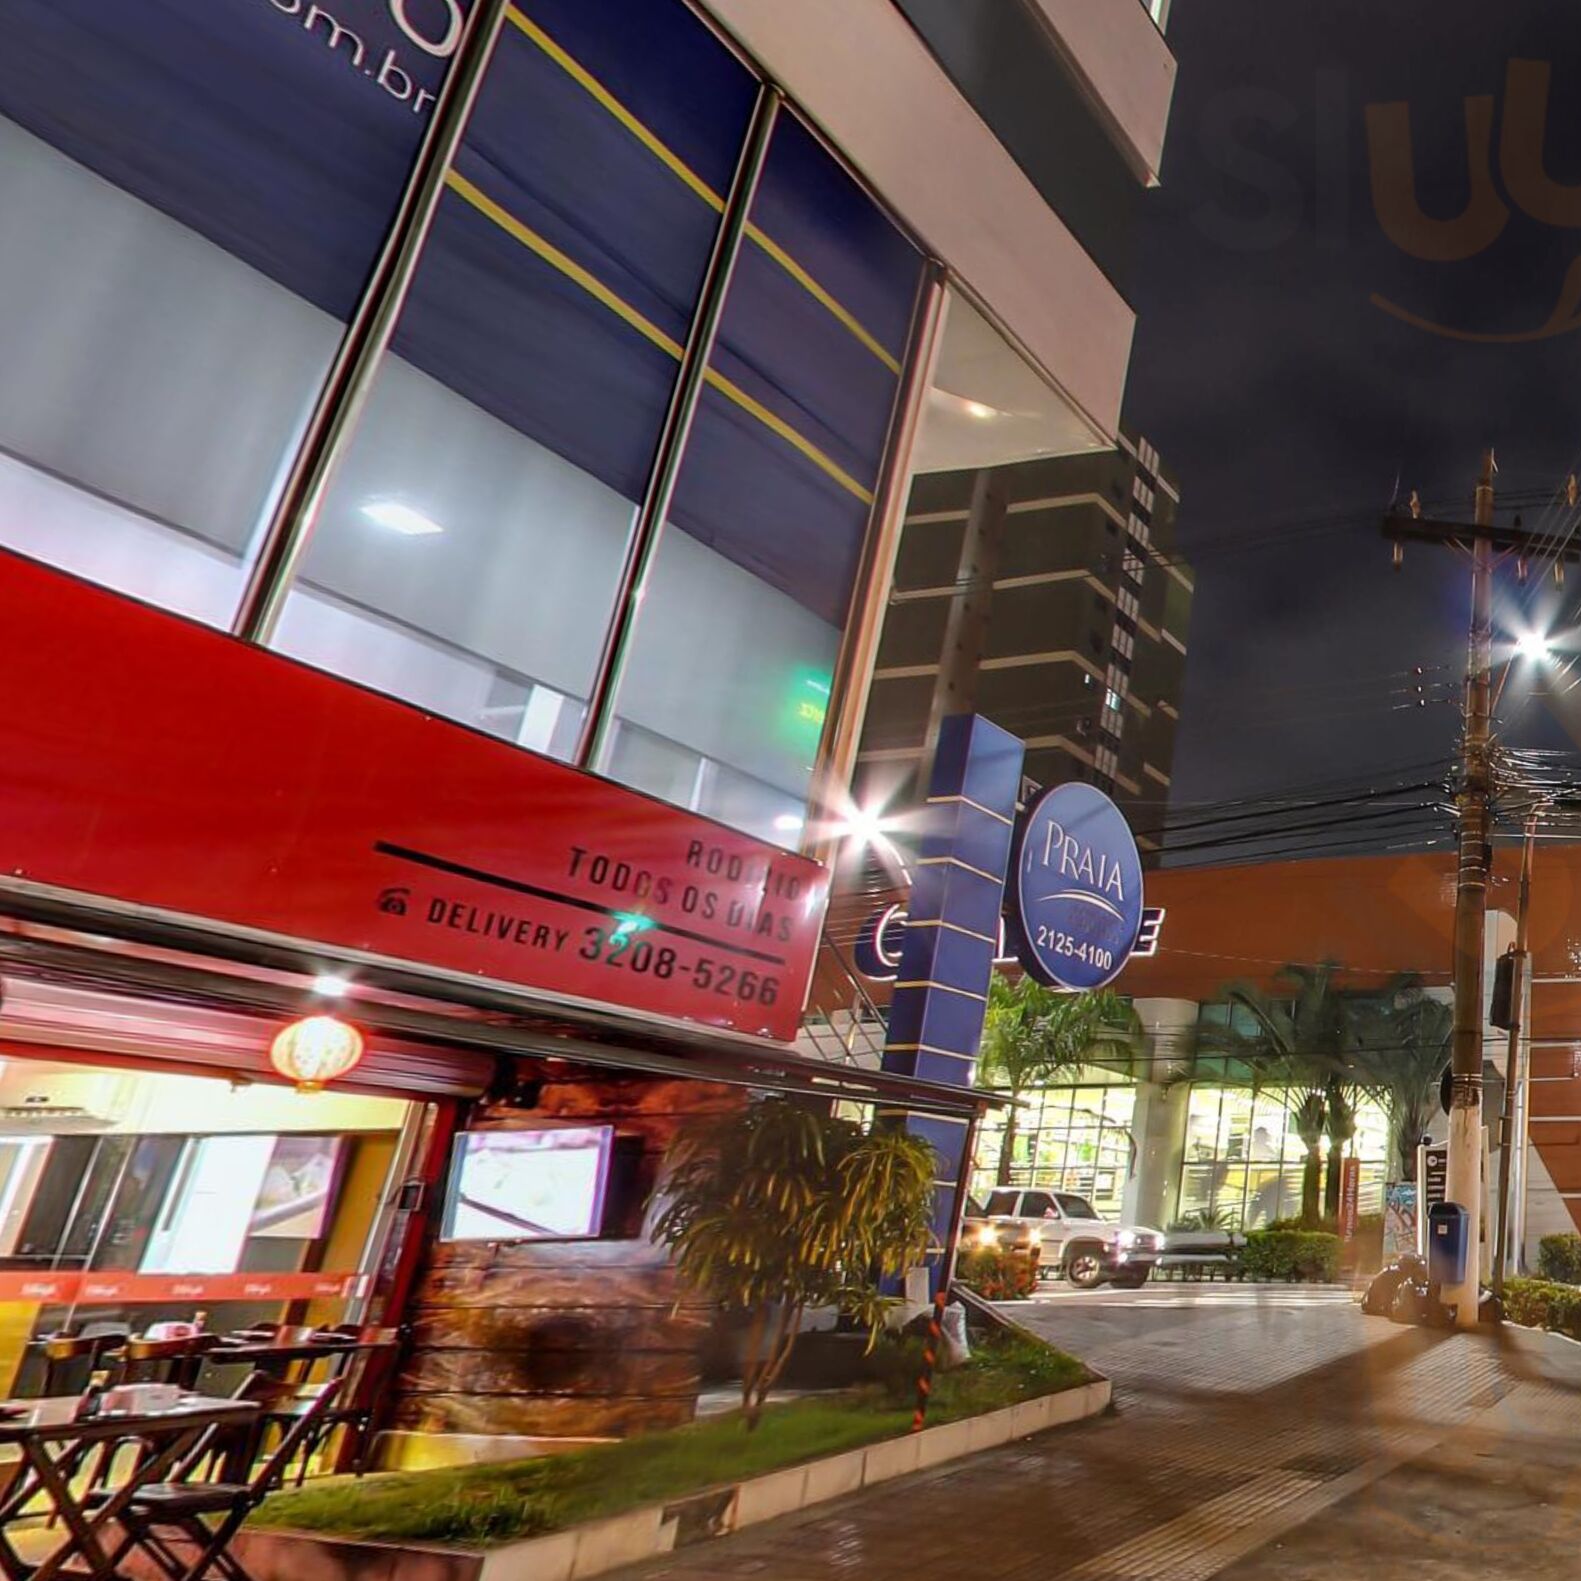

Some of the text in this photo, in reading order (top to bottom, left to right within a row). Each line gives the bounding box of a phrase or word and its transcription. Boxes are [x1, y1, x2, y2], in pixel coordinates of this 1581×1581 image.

[567, 846, 675, 905] TODOS
[681, 886, 720, 919] OS
[1042, 819, 1125, 902] PRAIA
[427, 897, 570, 952] DELIVERY
[578, 926, 781, 1007] 3208-5266
[1036, 925, 1114, 971] 2125-4100
